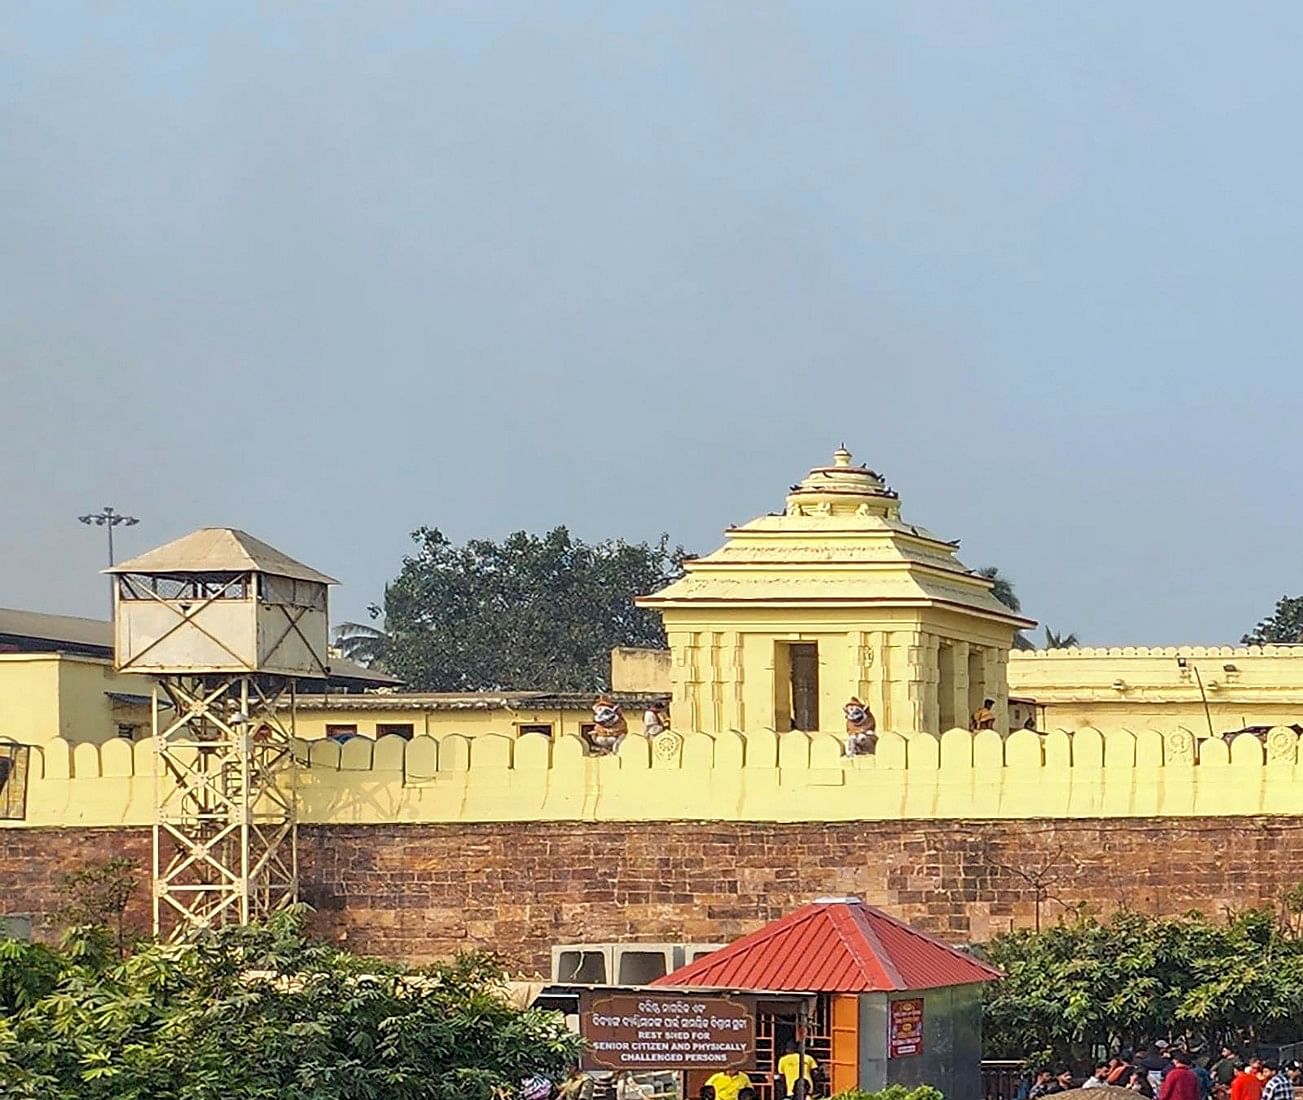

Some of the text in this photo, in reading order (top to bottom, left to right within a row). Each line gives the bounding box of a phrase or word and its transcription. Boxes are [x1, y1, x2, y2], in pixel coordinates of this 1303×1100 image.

[638, 1032, 710, 1040] REST SHED FOR
[593, 1042, 747, 1051] SENIOR CITIZEN AND PHYSICALLY
[620, 1053, 727, 1062] CHALLENGED PERSONS
